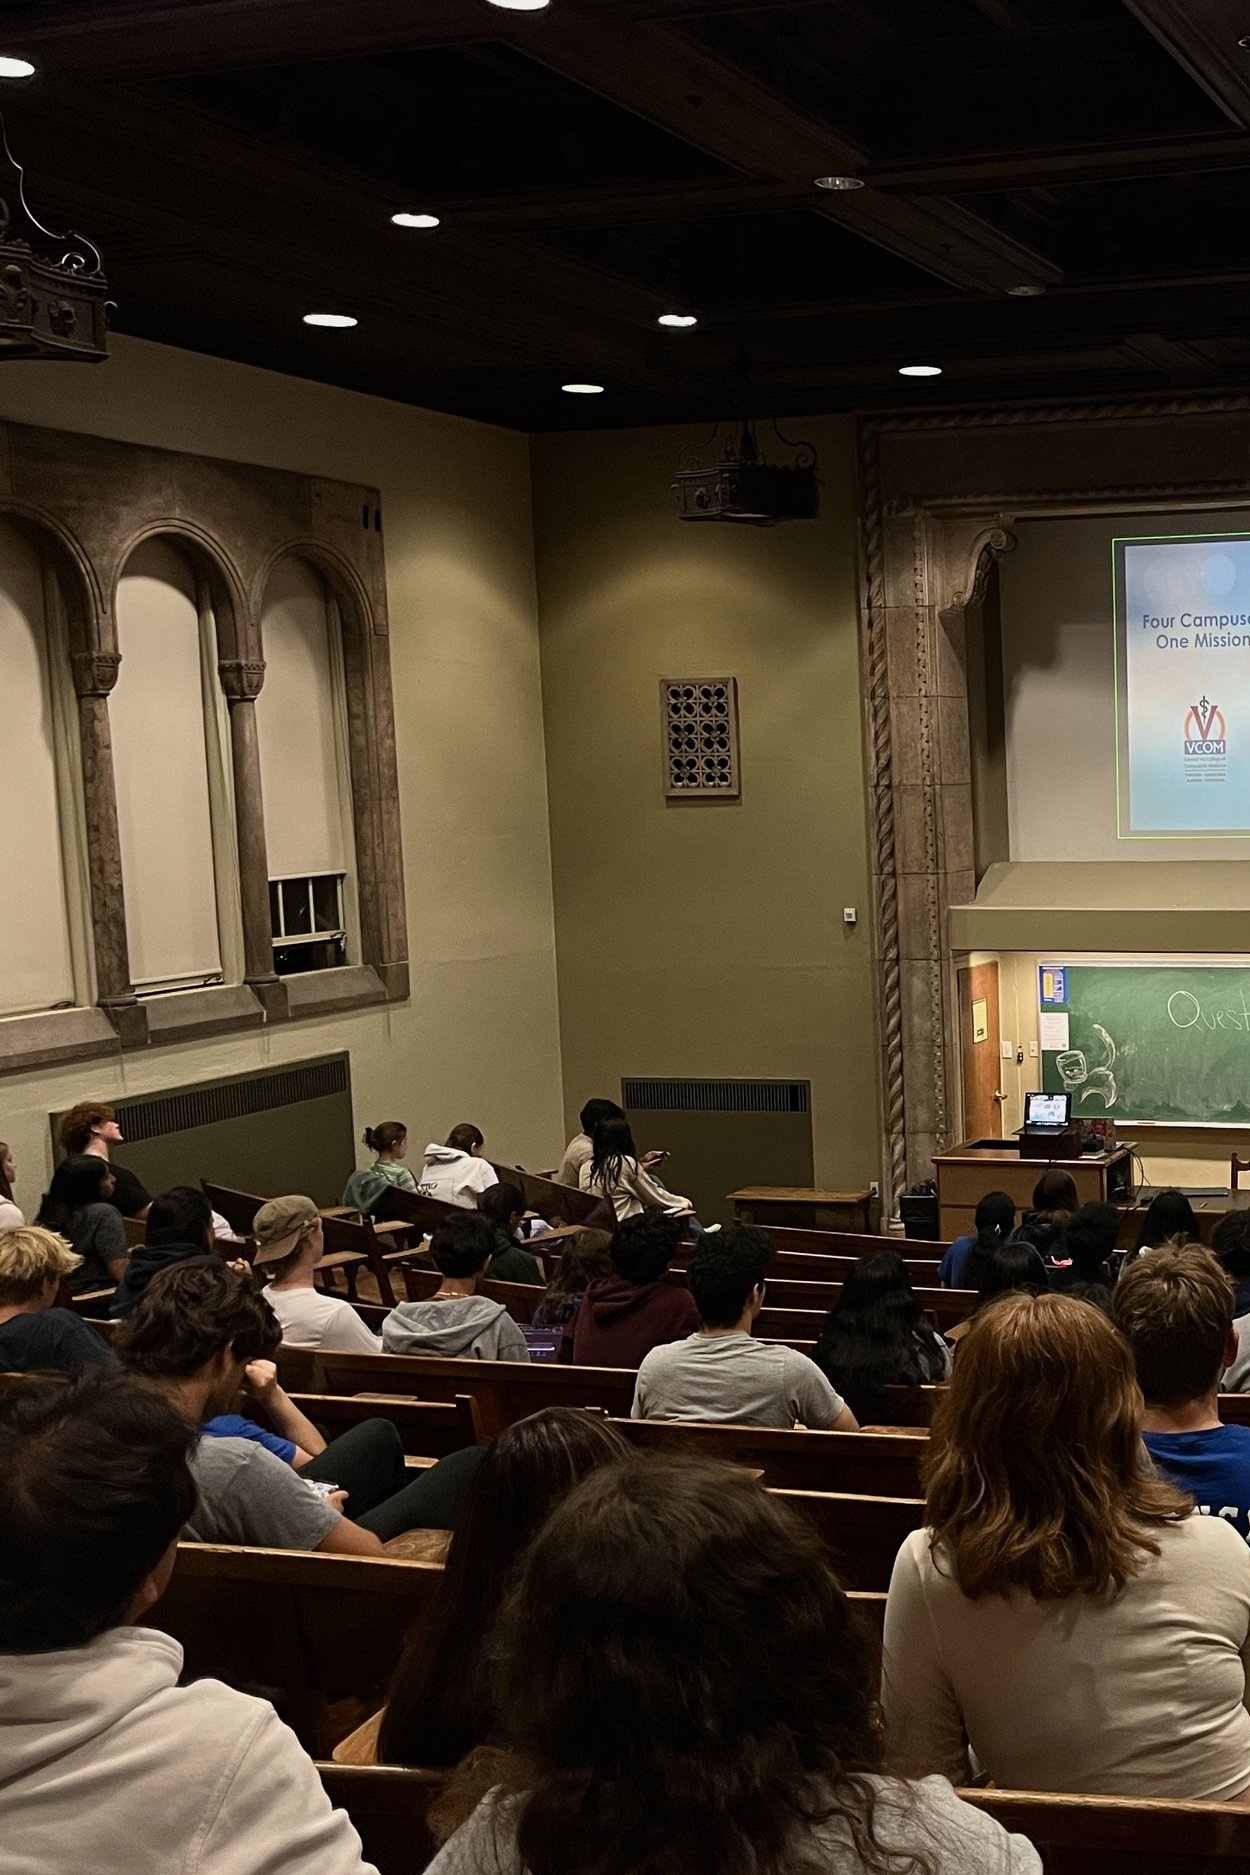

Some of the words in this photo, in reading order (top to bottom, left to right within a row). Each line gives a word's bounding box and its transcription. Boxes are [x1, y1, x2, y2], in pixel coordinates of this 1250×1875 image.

[1142, 614, 1176, 629] Four
[1156, 634, 1189, 649] One
[1185, 741, 1225, 755] VCOM
